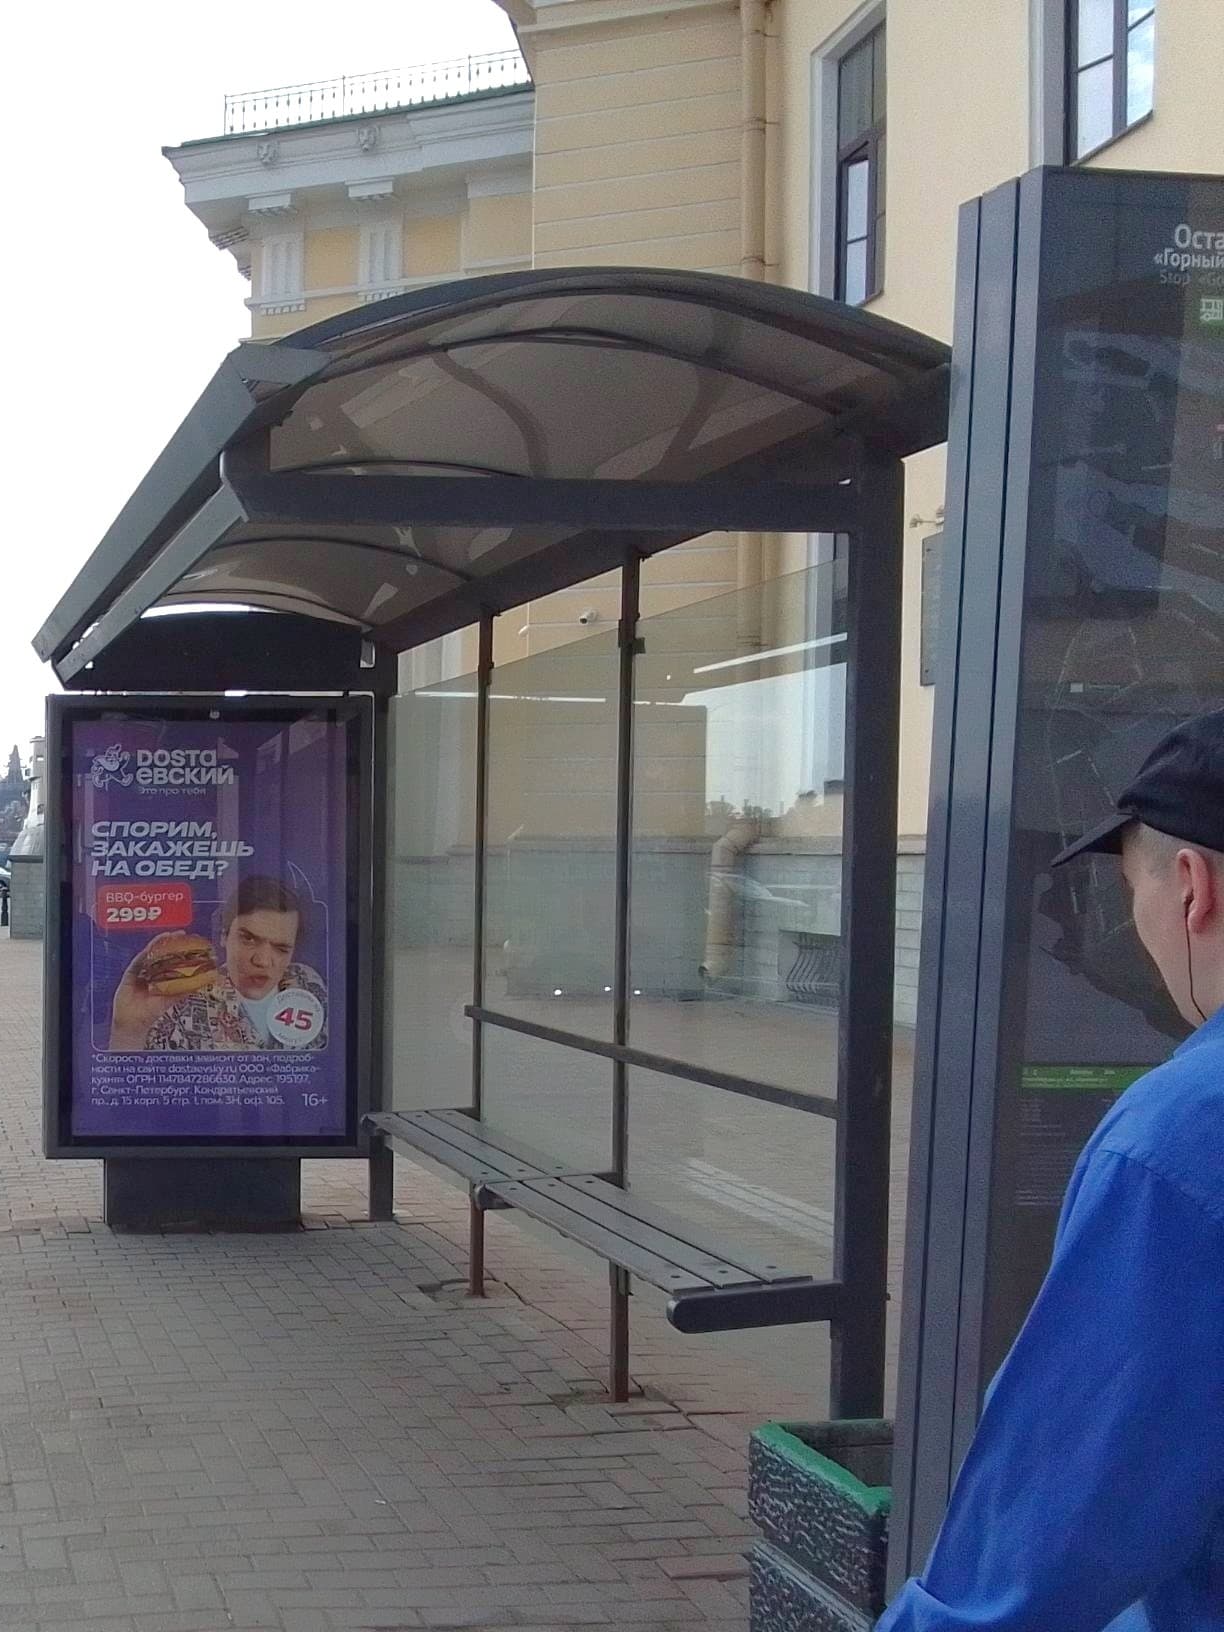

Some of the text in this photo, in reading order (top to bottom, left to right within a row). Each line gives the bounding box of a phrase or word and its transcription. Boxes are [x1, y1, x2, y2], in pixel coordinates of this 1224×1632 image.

[91, 821, 218, 839] СПОРИМ,
[90, 841, 254, 857] ЗАКАЖЕШЬ
[91, 860, 229, 879] НА ОБЕД?
[106, 891, 184, 905] BBQ-бургер
[275, 1007, 314, 1030] 45
[123, 1065, 136, 1073] на
[239, 1064, 265, 1073] ООО
[126, 1074, 156, 1083] ОГРН
[302, 1094, 328, 1106] 16+
